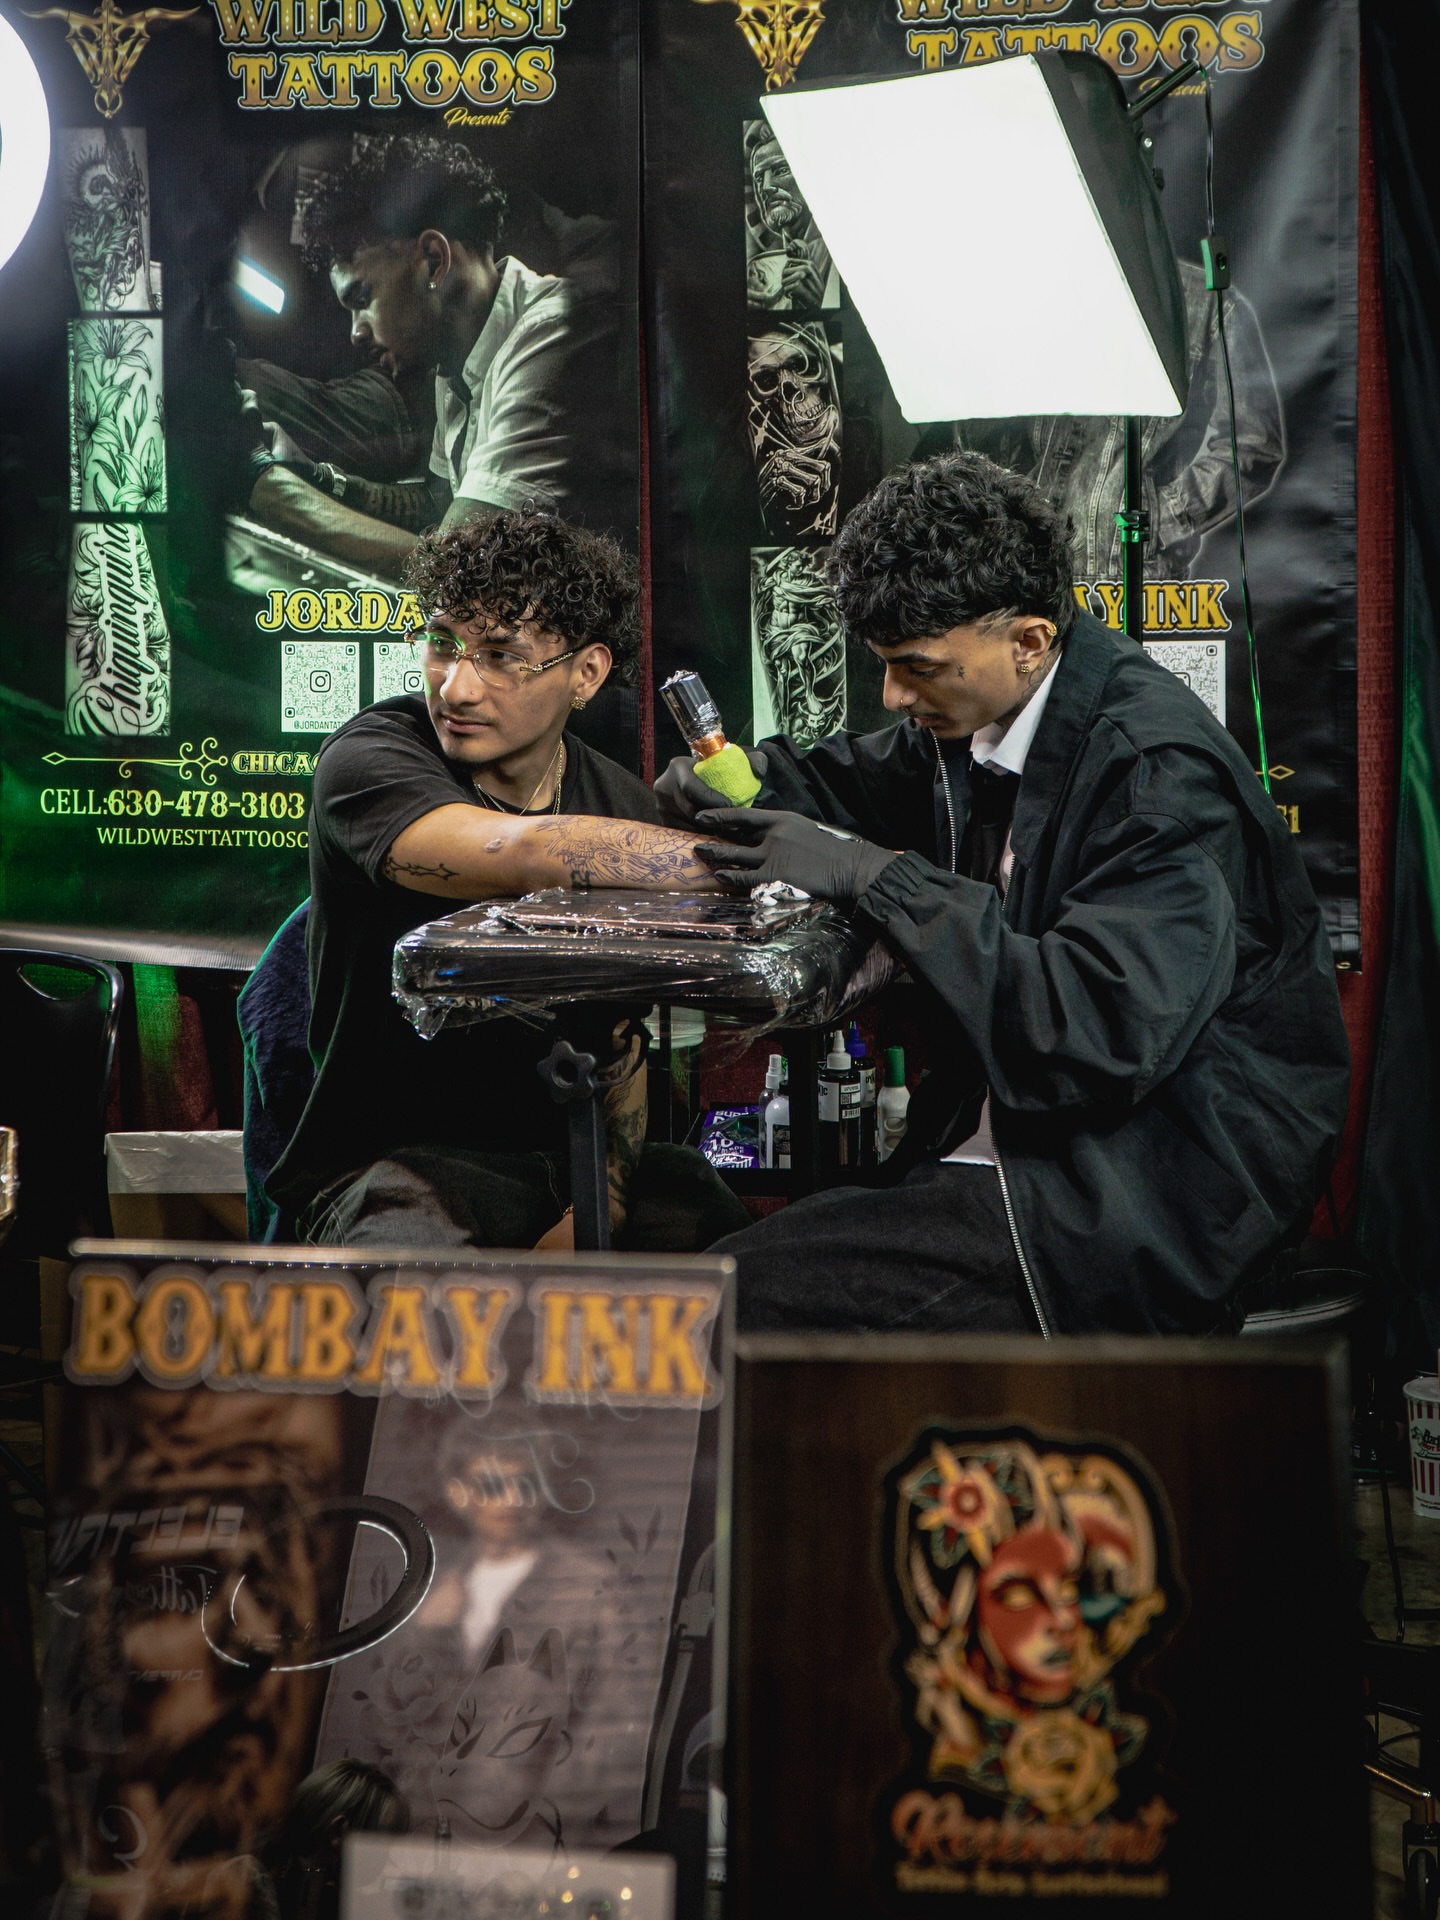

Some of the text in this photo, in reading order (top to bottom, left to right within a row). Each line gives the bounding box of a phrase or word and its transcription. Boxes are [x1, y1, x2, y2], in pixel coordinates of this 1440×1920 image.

[213, 0, 575, 46] WILD WEST
[228, 46, 557, 109] TATTOOS
[443, 107, 512, 128] Presents
[1144, 579, 1233, 633] INK
[293, 720, 345, 731] @JORDANTAT
[231, 751, 321, 774] CHICA
[40, 788, 305, 819] CELL:630-478-3103
[68, 1268, 518, 1395] BOMBAY
[534, 1285, 718, 1401] INK
